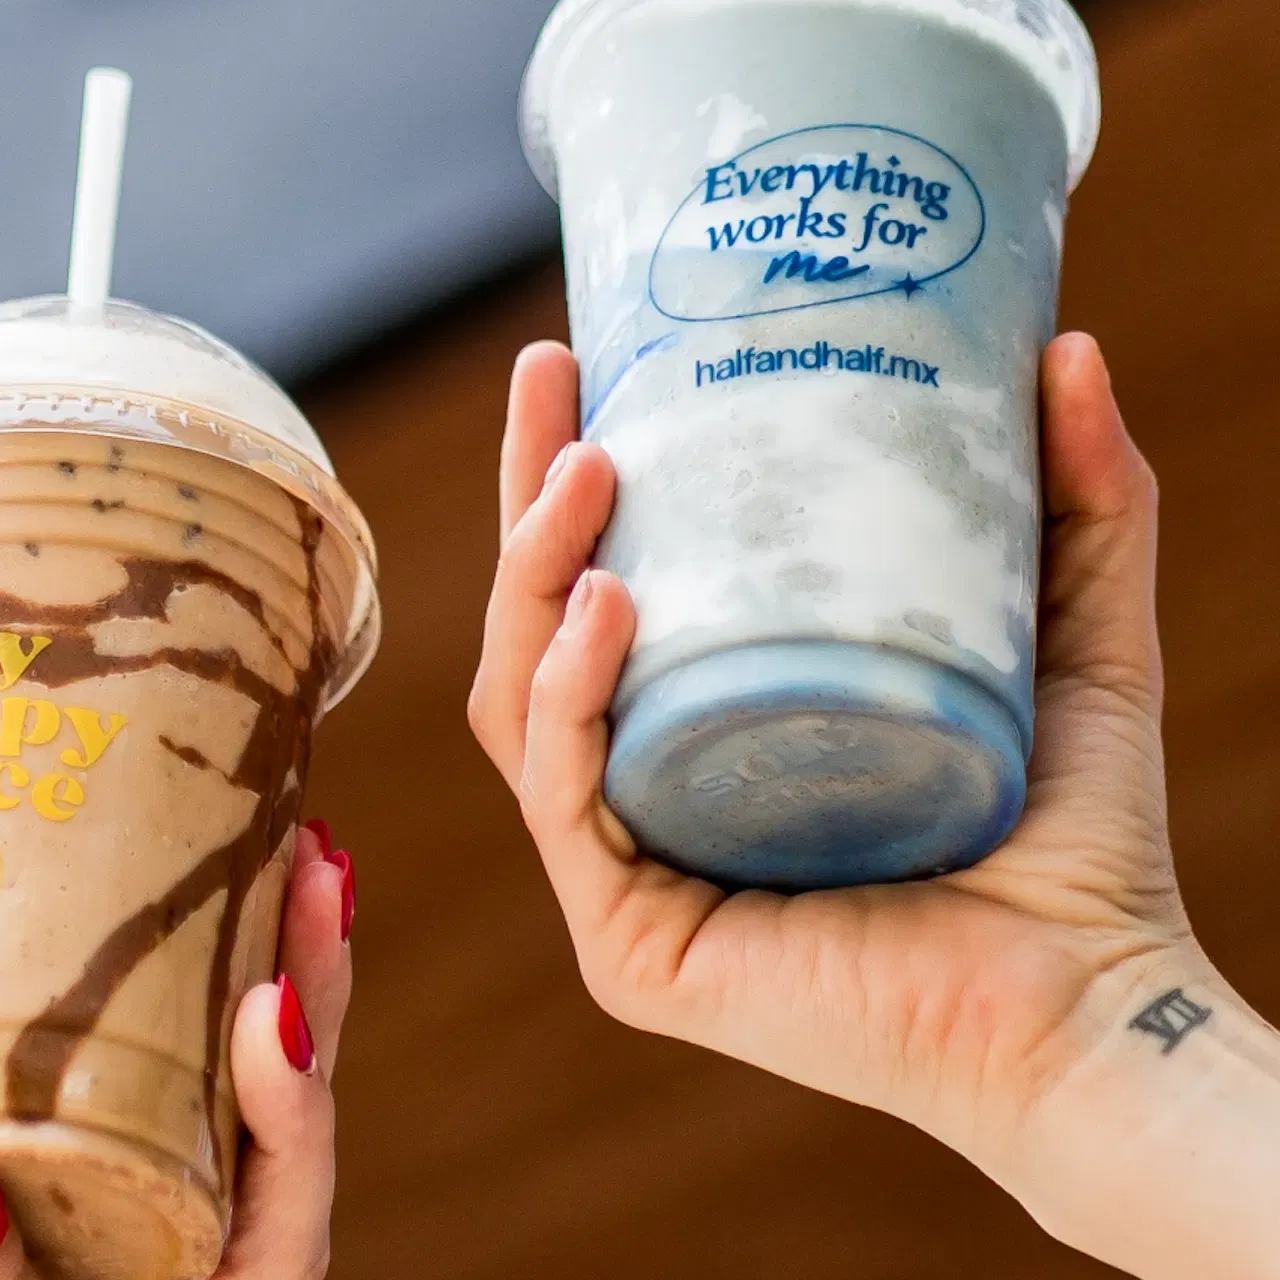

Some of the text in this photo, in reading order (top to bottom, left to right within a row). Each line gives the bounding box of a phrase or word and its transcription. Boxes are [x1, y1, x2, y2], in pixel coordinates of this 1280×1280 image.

[701, 152, 951, 222] Everything
[706, 196, 928, 252] works for
[763, 249, 871, 285] me
[695, 341, 940, 388] halfandhalf.mx
